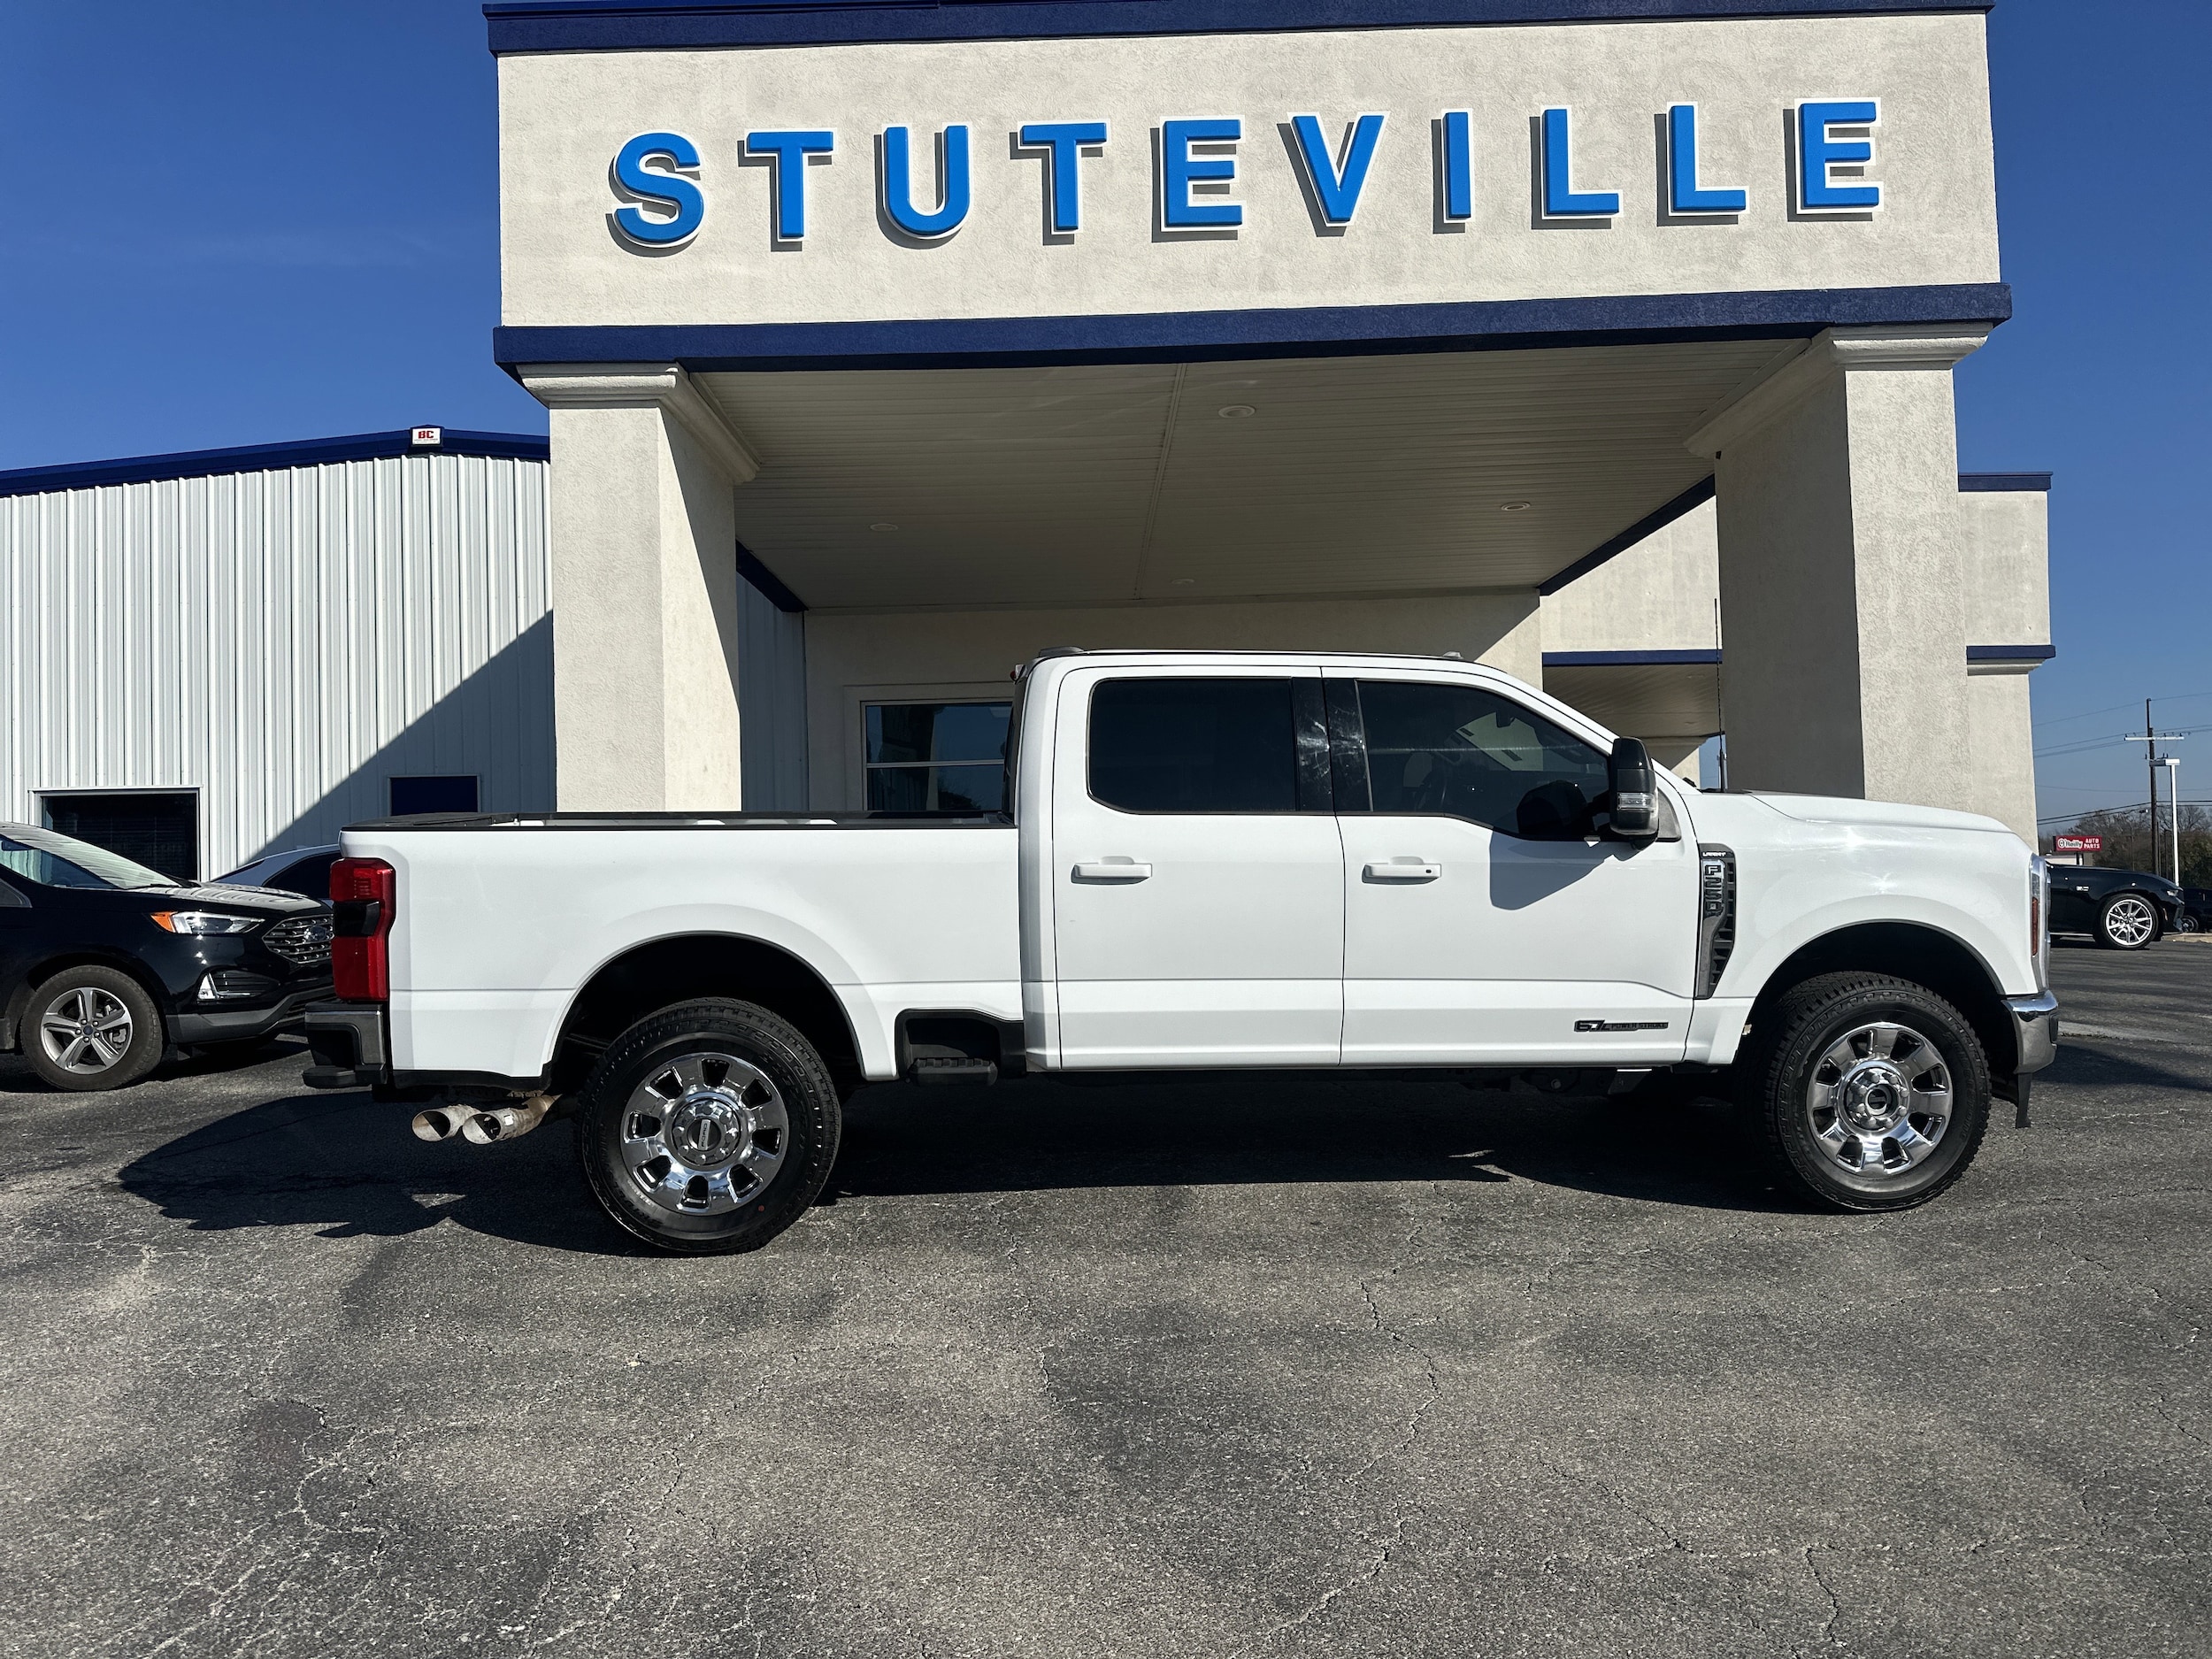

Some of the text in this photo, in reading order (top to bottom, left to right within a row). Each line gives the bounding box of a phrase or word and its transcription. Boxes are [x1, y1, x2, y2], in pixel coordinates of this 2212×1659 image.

[611, 97, 1880, 249] STUTEVILLE
[418, 430, 434, 439] BC
[2058, 838, 2083, 849] O'Reilly
